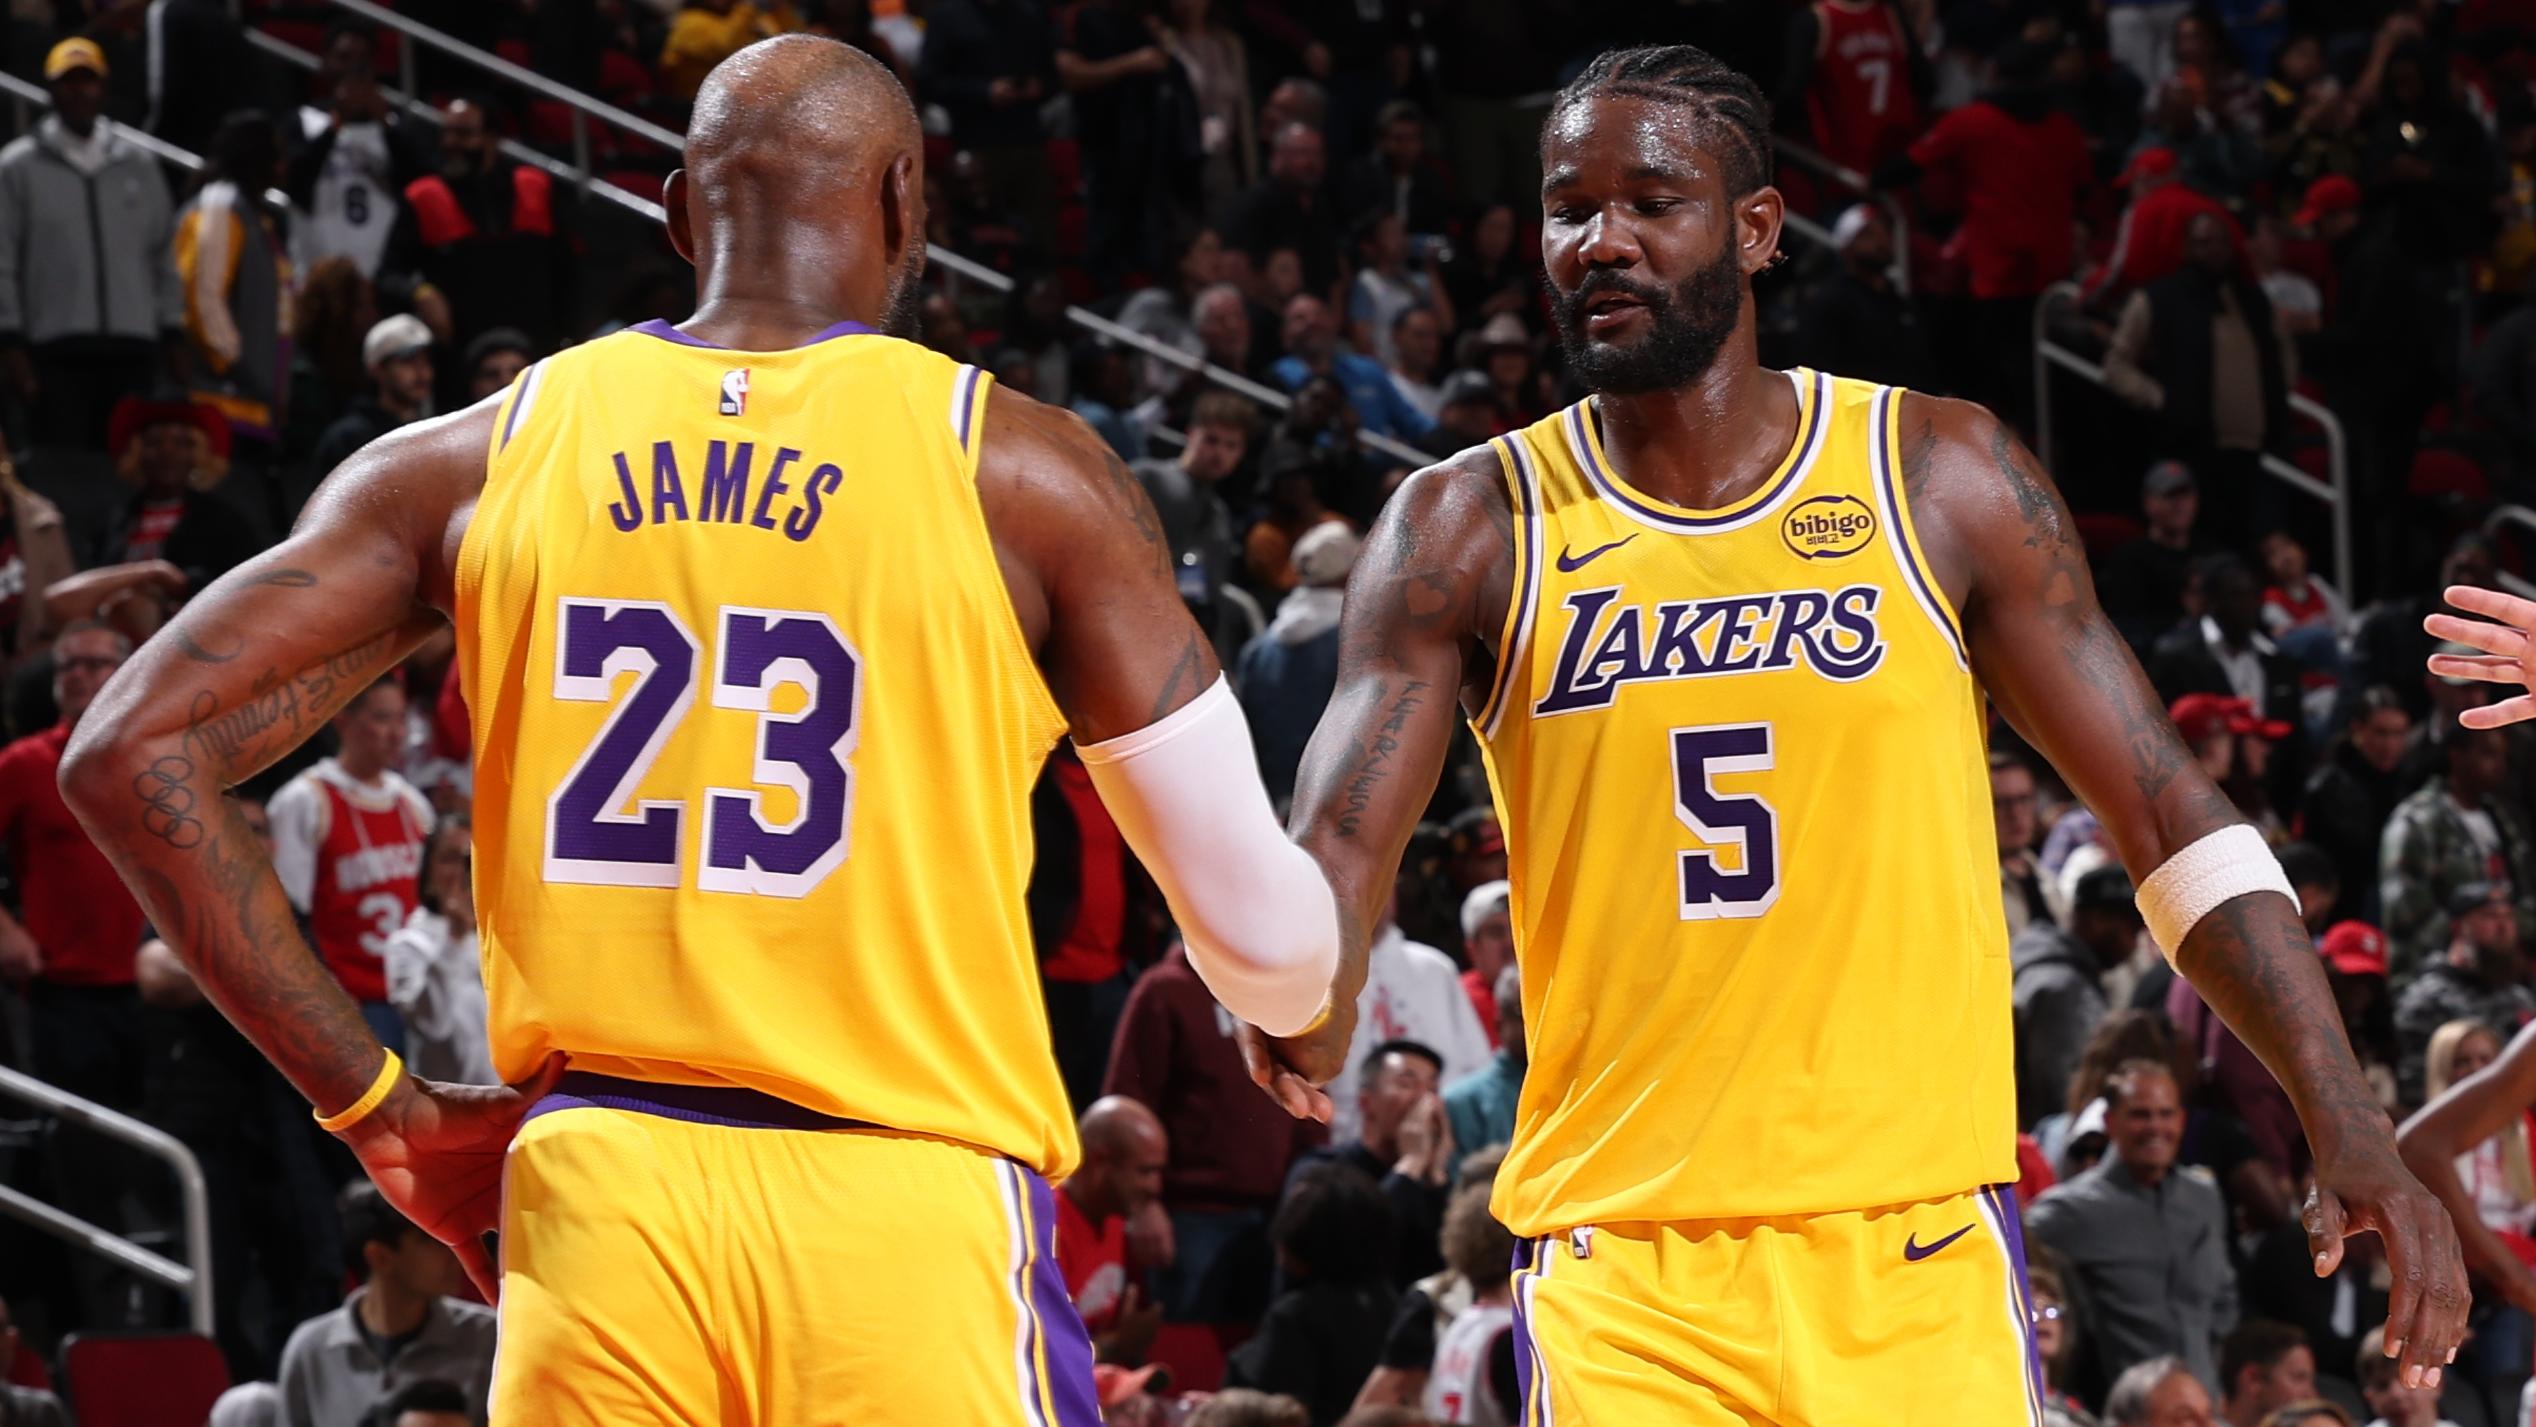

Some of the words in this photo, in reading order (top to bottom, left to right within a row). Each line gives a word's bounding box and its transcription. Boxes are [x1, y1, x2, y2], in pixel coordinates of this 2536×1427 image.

[1856, 59, 1890, 114] 7
[345, 185, 369, 225] 6
[608, 440, 843, 541] JAMES
[1790, 511, 1869, 537] bibigo
[1806, 533, 1840, 545] 비비고
[1531, 583, 1888, 719] LAKERS
[543, 596, 862, 898] 23
[1669, 721, 1780, 920] 5
[357, 891, 404, 957] 3
